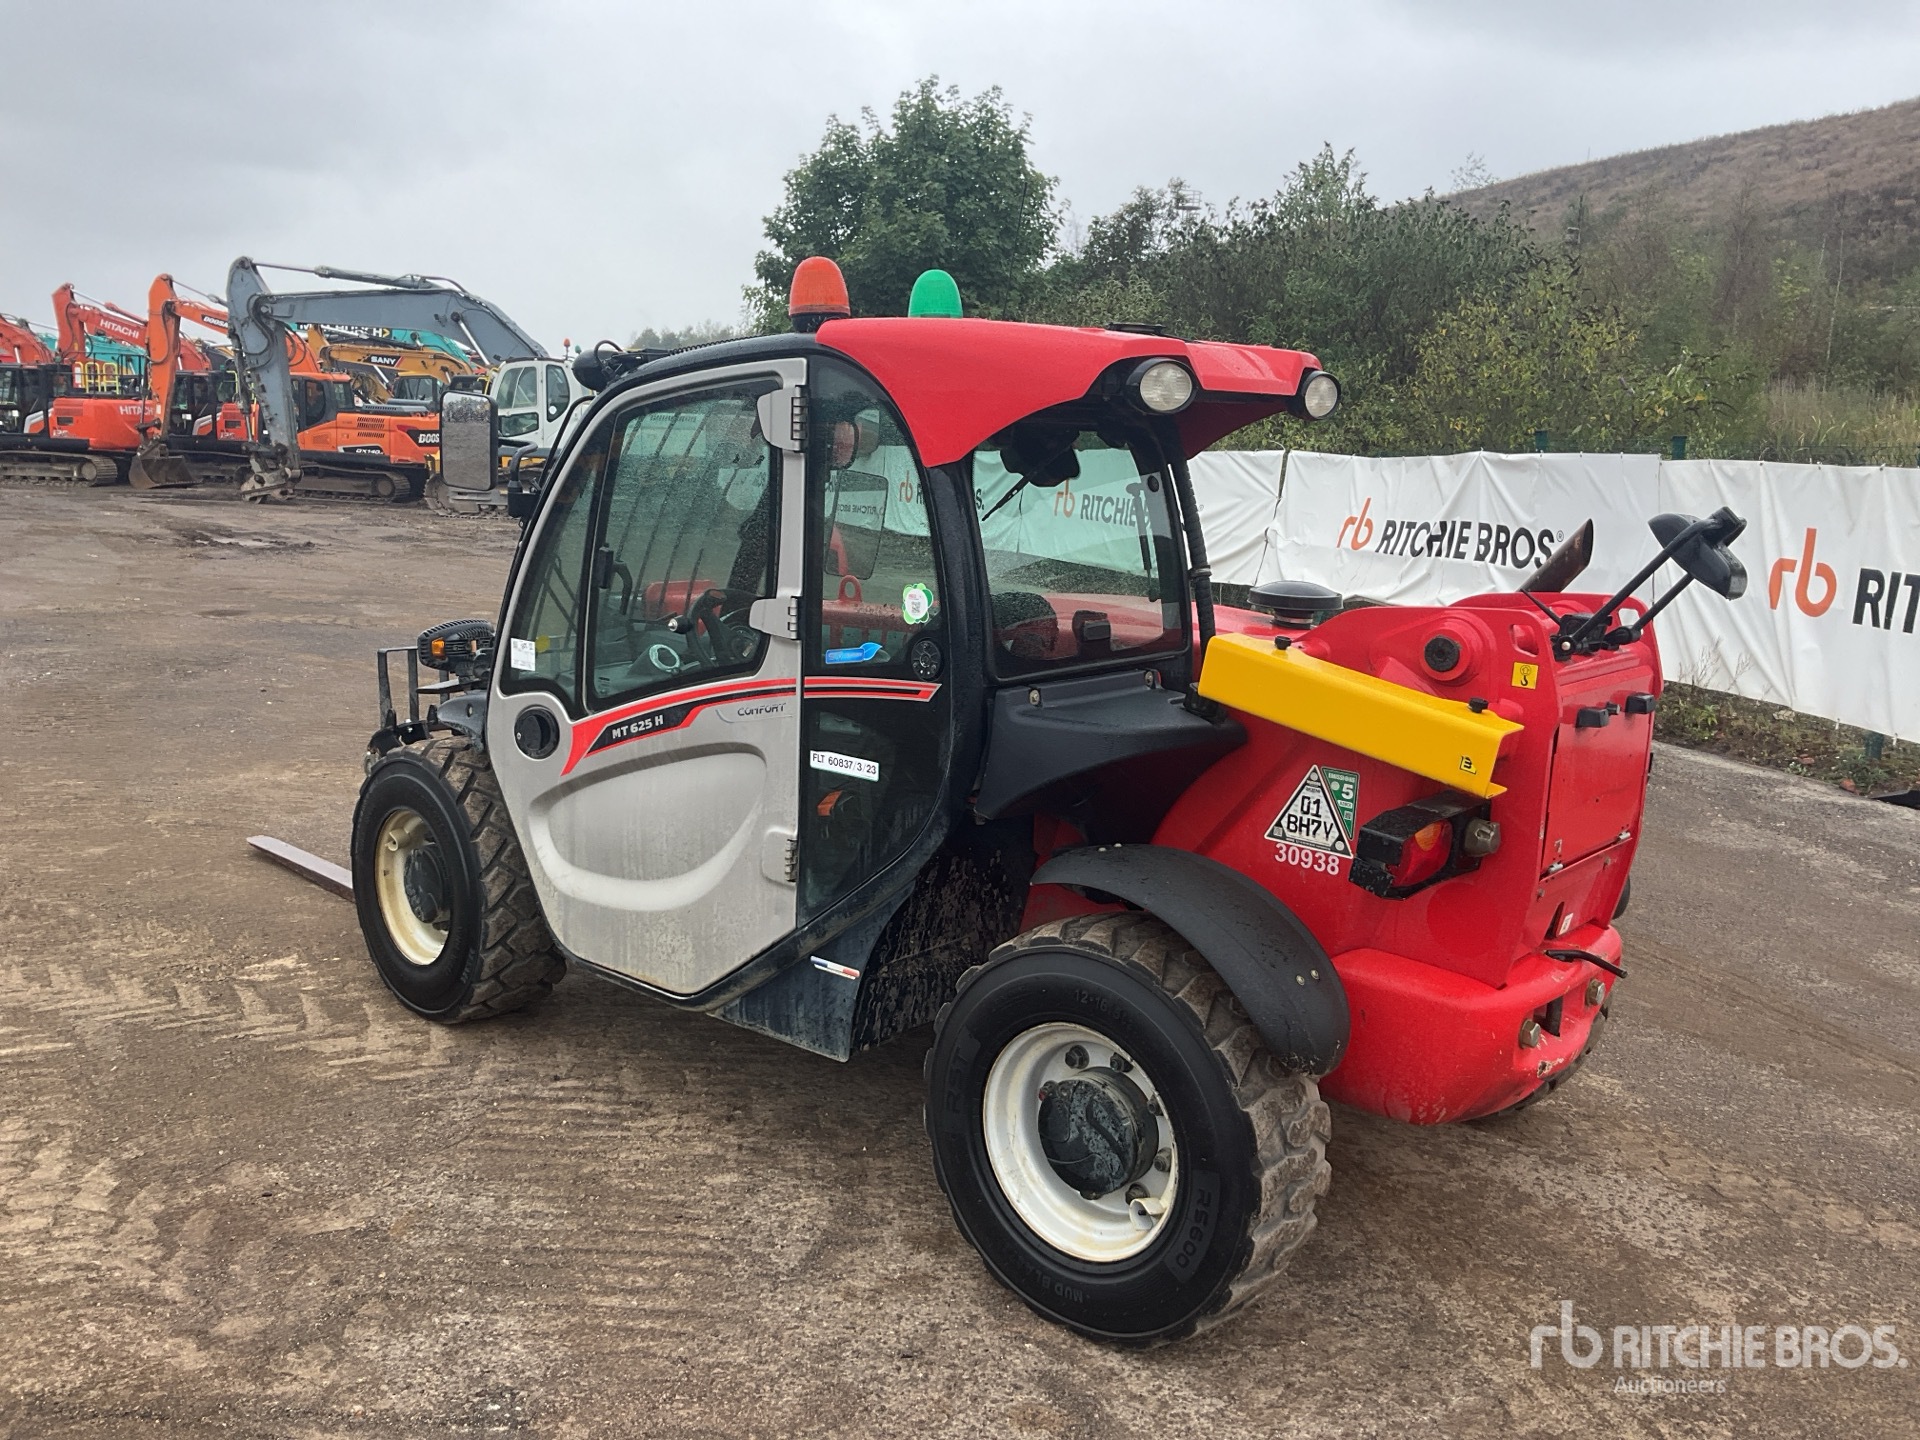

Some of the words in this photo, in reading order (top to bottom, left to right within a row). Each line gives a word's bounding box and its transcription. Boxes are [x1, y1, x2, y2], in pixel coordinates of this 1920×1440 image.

[100, 319, 139, 339] HITACHI
[204, 315, 228, 328] DOOSA
[370, 355, 396, 366] SANY
[119, 405, 154, 415] HITACH
[418, 433, 440, 444] DOOS
[1375, 519, 1472, 560] RITCHIE
[612, 725, 629, 739] MT
[630, 718, 653, 733] 625
[654, 714, 664, 726] H
[812, 753, 826, 763] FLT
[1341, 783, 1354, 800] 5
[1286, 813, 1334, 839] BH7Y
[1274, 842, 1340, 876] 30938
